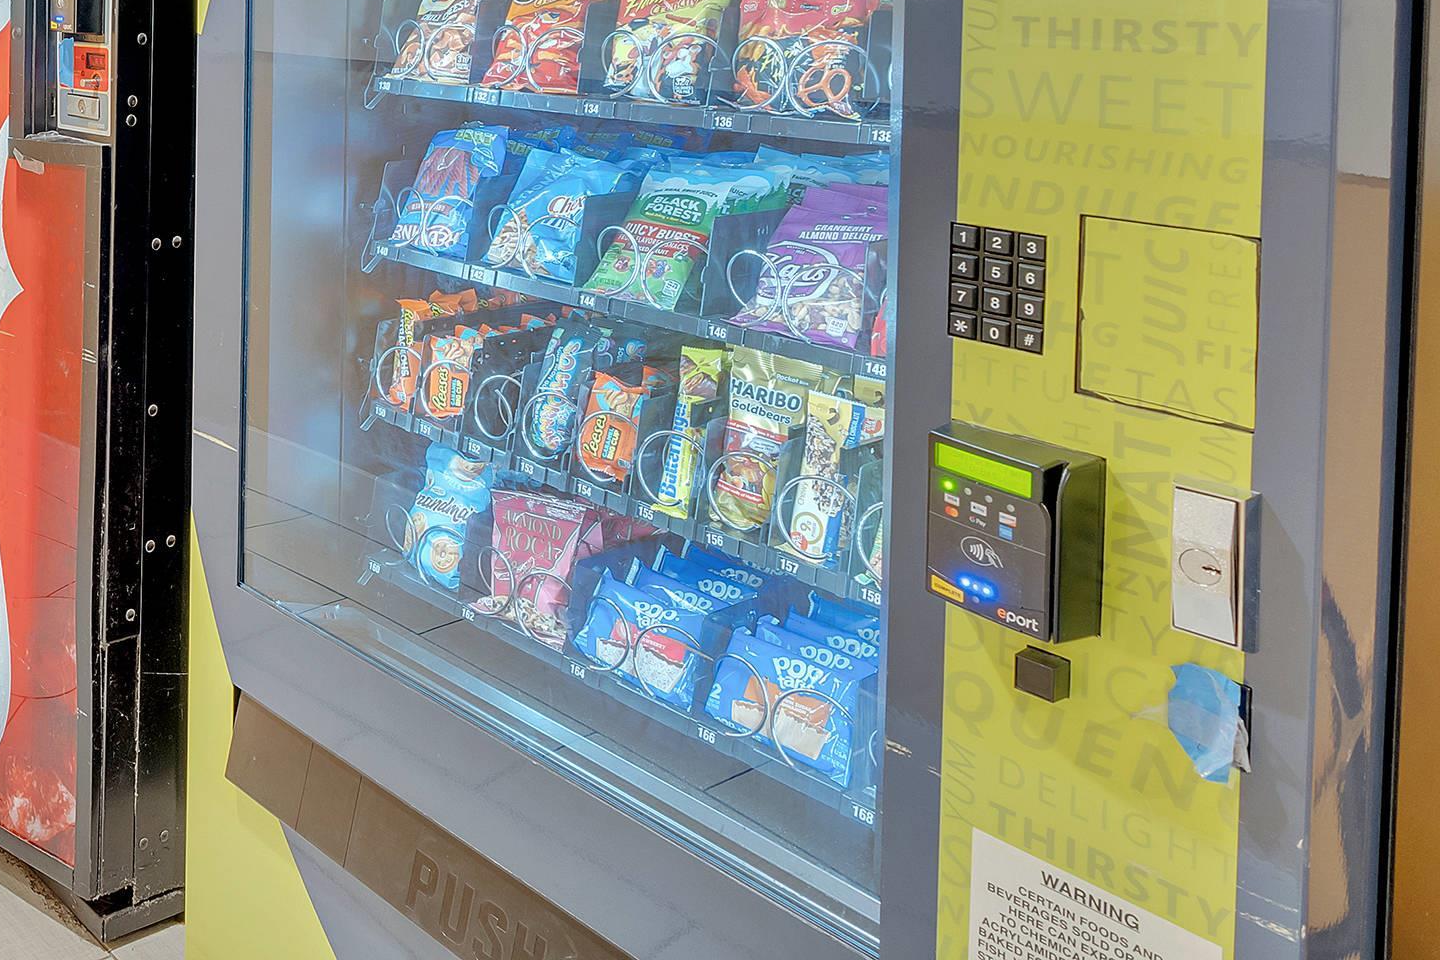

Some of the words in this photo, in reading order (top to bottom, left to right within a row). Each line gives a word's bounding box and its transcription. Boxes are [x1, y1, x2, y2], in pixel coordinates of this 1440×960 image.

[1012, 15, 1263, 58] THIRSTY
[474, 92, 488, 101] 132
[962, 67, 1256, 140] SWEET
[583, 102, 599, 114] 134
[714, 116, 732, 128] 136
[960, 132, 1250, 185] NOURISHING
[548, 194, 588, 216] Chex
[653, 196, 700, 212] BLACK
[798, 232, 838, 240] ALMOND
[842, 232, 884, 241] DELIGHT
[814, 224, 872, 233] CRANBERRY
[959, 231, 968, 243] 1
[992, 236, 1002, 248] 2
[1026, 242, 1037, 254] 3
[958, 261, 968, 273] 4
[990, 266, 1002, 278] 5
[1024, 272, 1036, 284] 6
[580, 296, 594, 307] 144
[956, 290, 966, 302] 7
[990, 296, 1000, 309] 8
[1024, 302, 1034, 316] 9
[708, 326, 727, 338] 146
[990, 327, 1000, 340] 0
[1024, 334, 1034, 346] #
[865, 362, 887, 377] 148
[730, 378, 802, 412] HARIBO
[732, 400, 791, 424] Goldbears
[419, 423, 432, 436] 151
[468, 442, 480, 454] 152
[660, 399, 689, 500] Butterfinger
[520, 462, 534, 475] 153
[576, 483, 592, 497] 154
[638, 506, 654, 521] 155
[502, 510, 562, 540] ALMOND
[505, 526, 564, 560] ROCA
[706, 531, 724, 547] 156
[780, 558, 799, 574] 157
[861, 588, 881, 604] 158
[461, 609, 475, 622] 162
[996, 608, 1040, 632] eport
[570, 664, 586, 679] 164
[697, 726, 716, 744] 166
[852, 805, 874, 824] 168
[988, 800, 1231, 938] THIRSTY
[405, 848, 548, 960] PUSH
[1041, 869, 1140, 930] WARNING
[986, 882, 1068, 930] BEVERAGES
[1072, 925, 1111, 952] SOLD
[999, 912, 1017, 929] TO
[1018, 886, 1076, 922] CERTAIN
[1080, 917, 1129, 948] FOODS
[1009, 905, 1044, 935] HERE
[1048, 927, 1076, 949] CAN
[978, 926, 1023, 956] BAKED
[978, 940, 1006, 959] FISH
